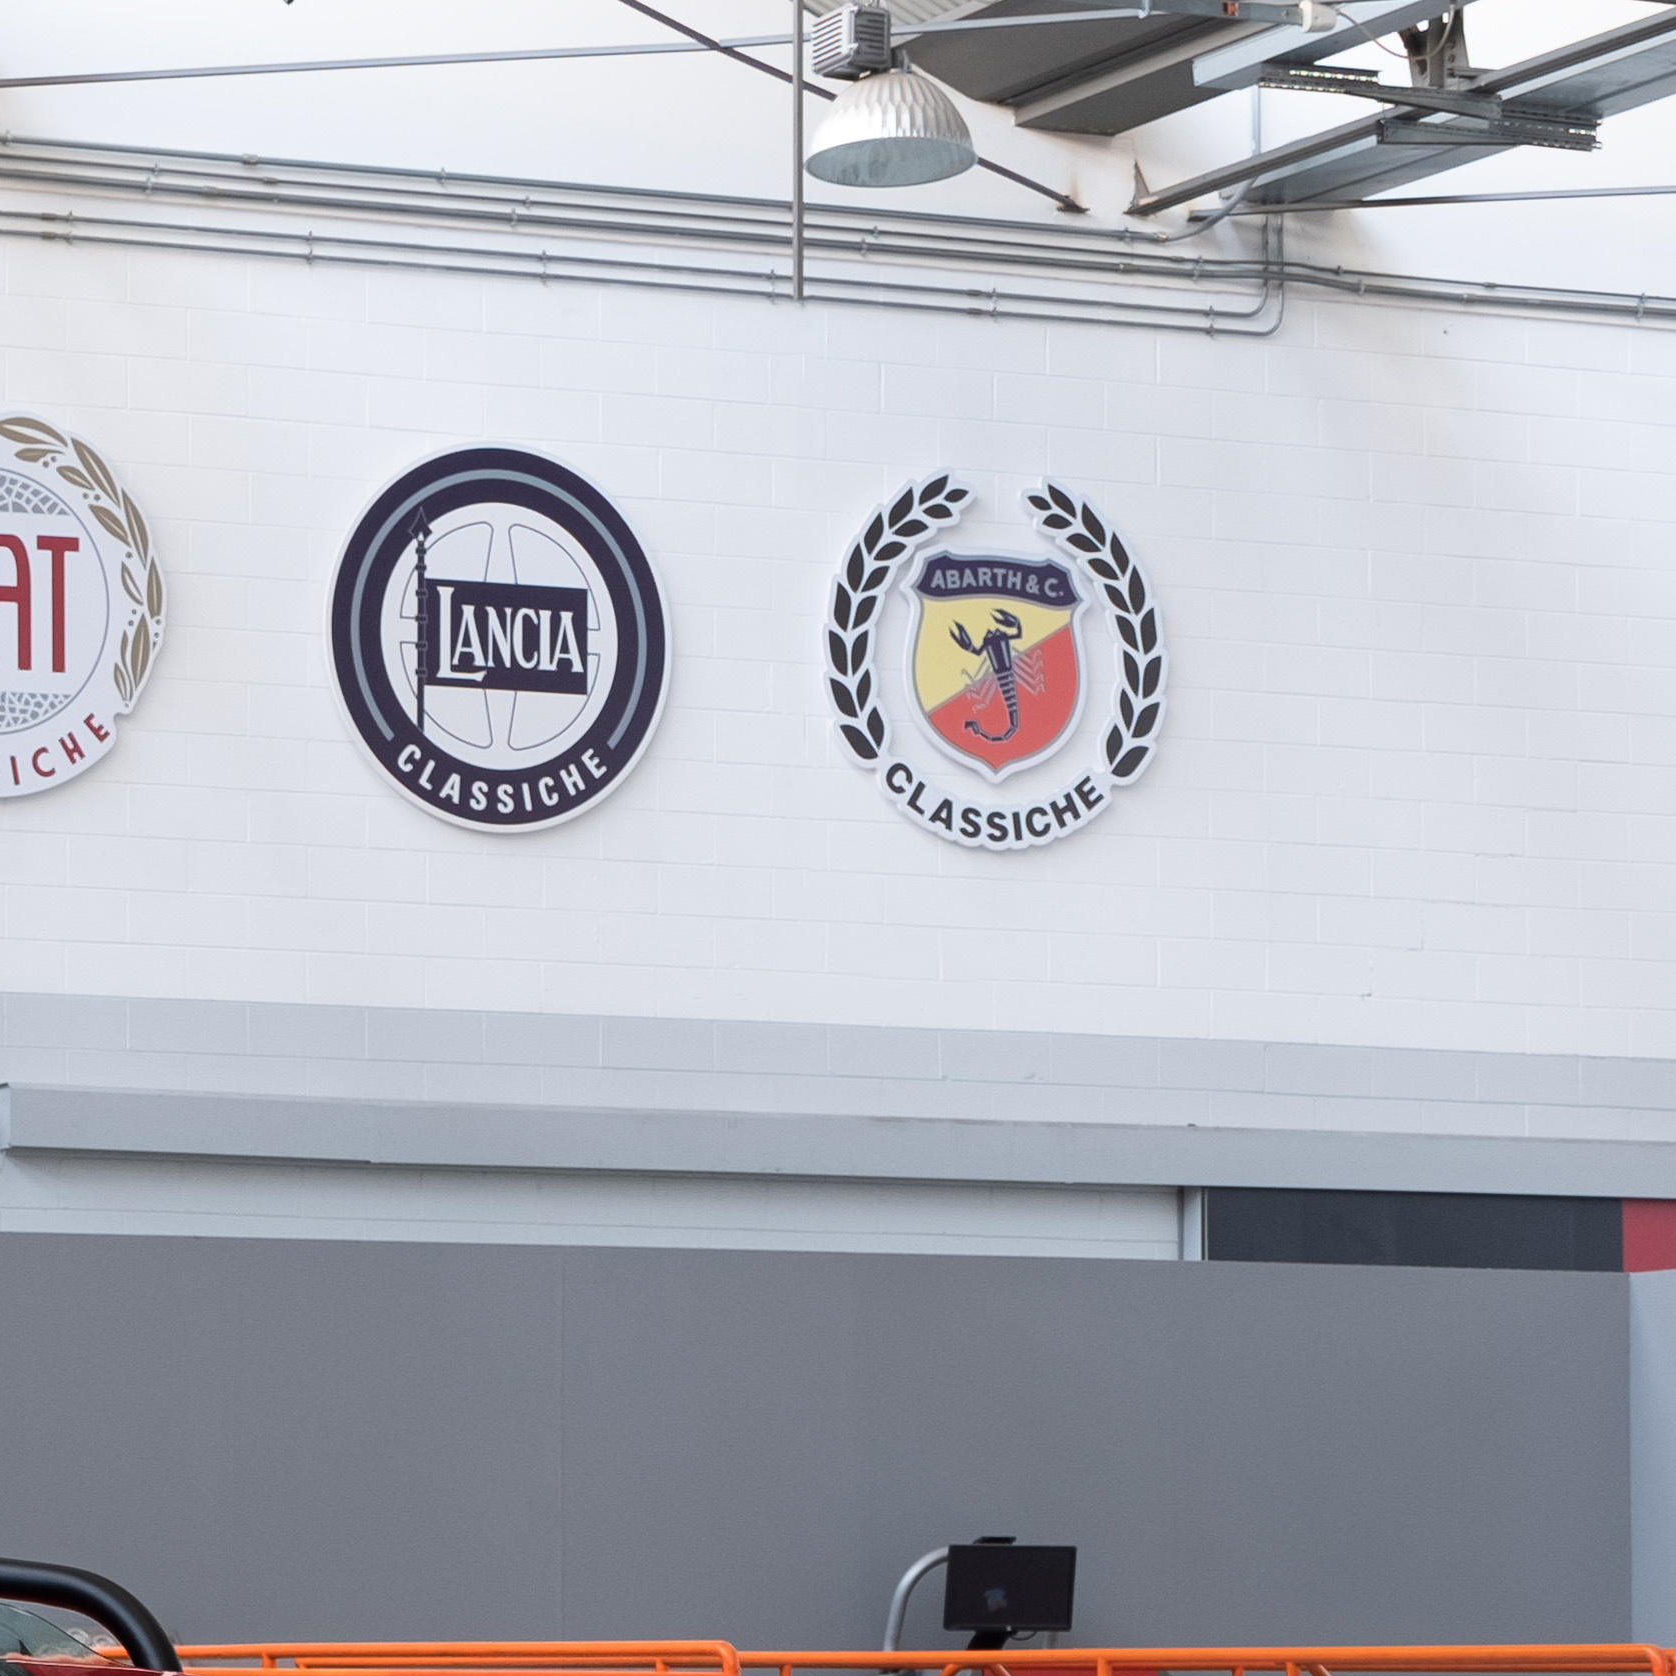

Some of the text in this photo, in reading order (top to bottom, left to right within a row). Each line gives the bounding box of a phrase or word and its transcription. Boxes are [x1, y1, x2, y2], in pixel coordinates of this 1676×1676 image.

[930, 567, 1022, 591] ABARTH
[1025, 573, 1040, 595] &
[437, 585, 584, 680] LANCIA
[396, 742, 609, 816] CLASSICHE
[884, 762, 1106, 844] CLASSICHE
